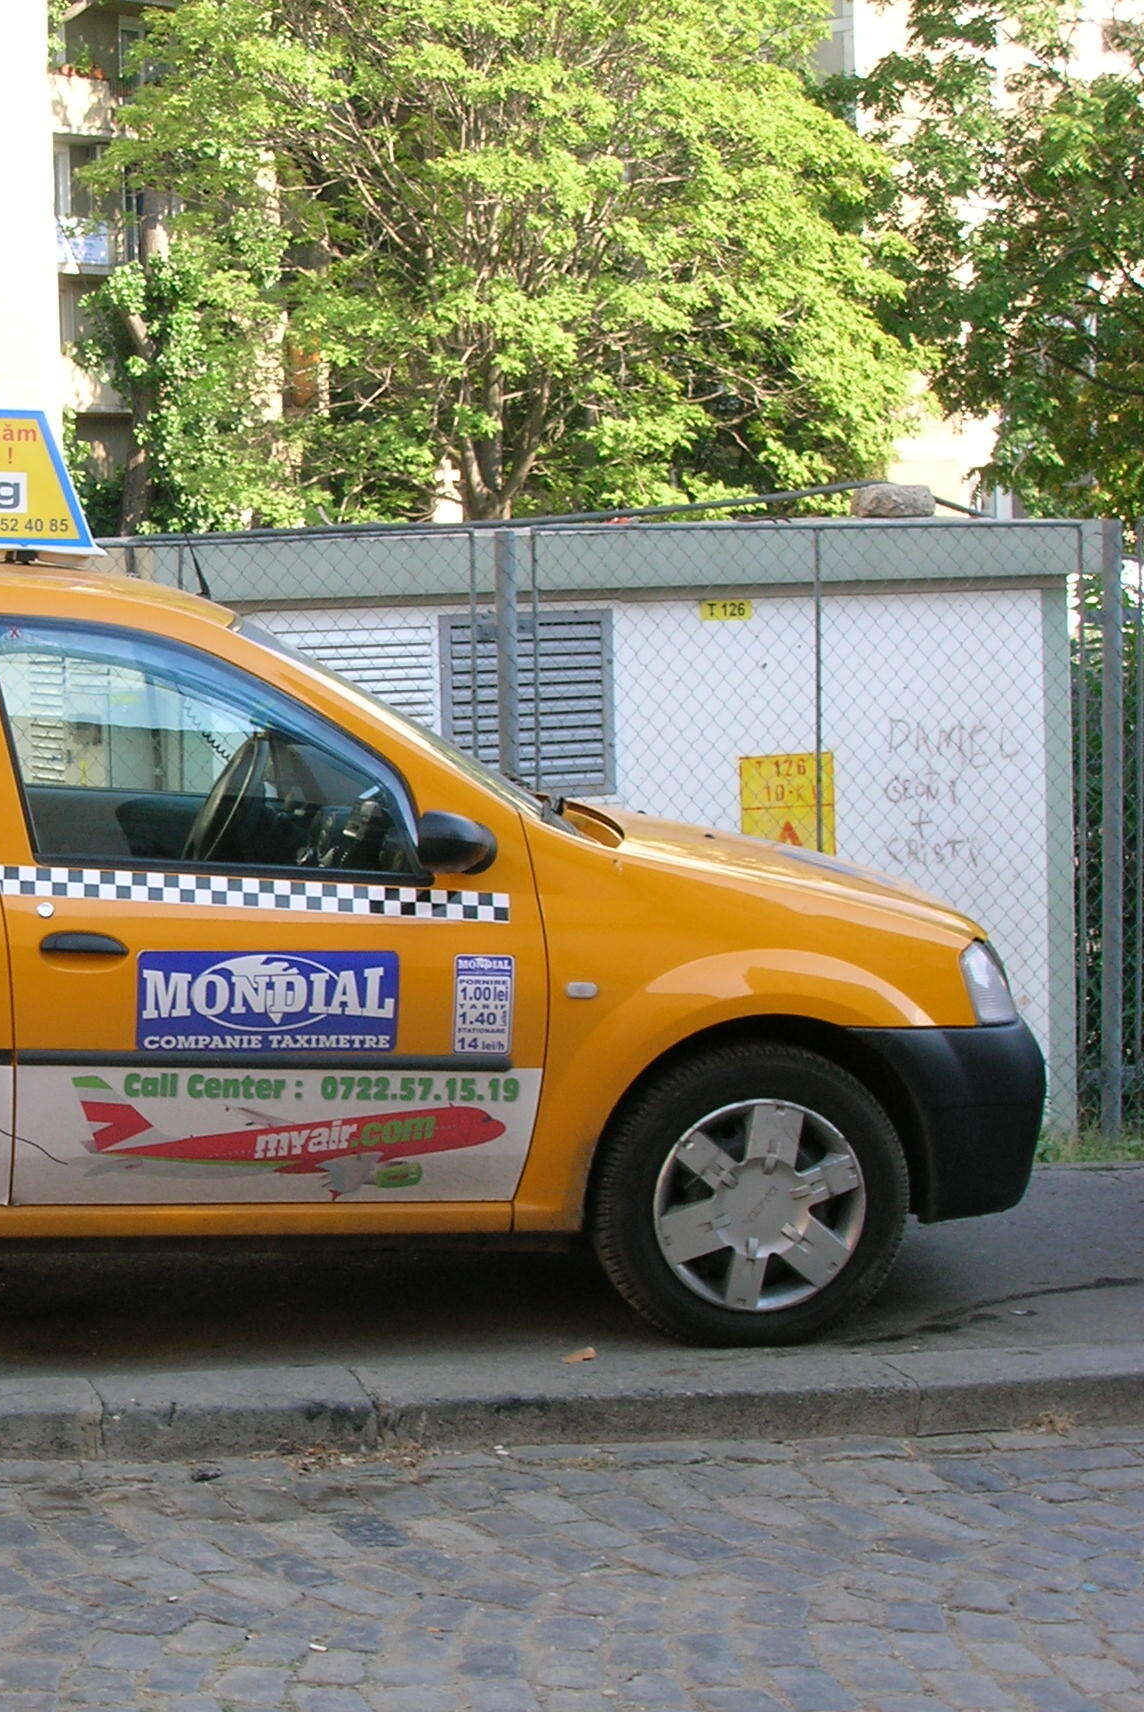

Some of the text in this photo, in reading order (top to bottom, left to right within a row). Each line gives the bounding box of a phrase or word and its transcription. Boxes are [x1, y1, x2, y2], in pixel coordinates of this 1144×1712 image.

[7, 447, 13, 464] !
[24, 517, 44, 532] 40
[49, 517, 69, 532] 85
[706, 602, 746, 617] T 126
[457, 958, 512, 970] MONDIAL
[142, 967, 396, 1025] MONDIAL
[460, 986, 509, 1001] 1.00 lei
[459, 1012, 497, 1025] 1.40
[143, 1034, 391, 1049] COMPANIE TAXIMETRE
[457, 1037, 479, 1050] 14
[124, 1073, 178, 1098] Call
[187, 1074, 286, 1099] Center
[320, 1076, 520, 1102] 0722.57.15.19
[254, 1115, 437, 1159] myair.com
